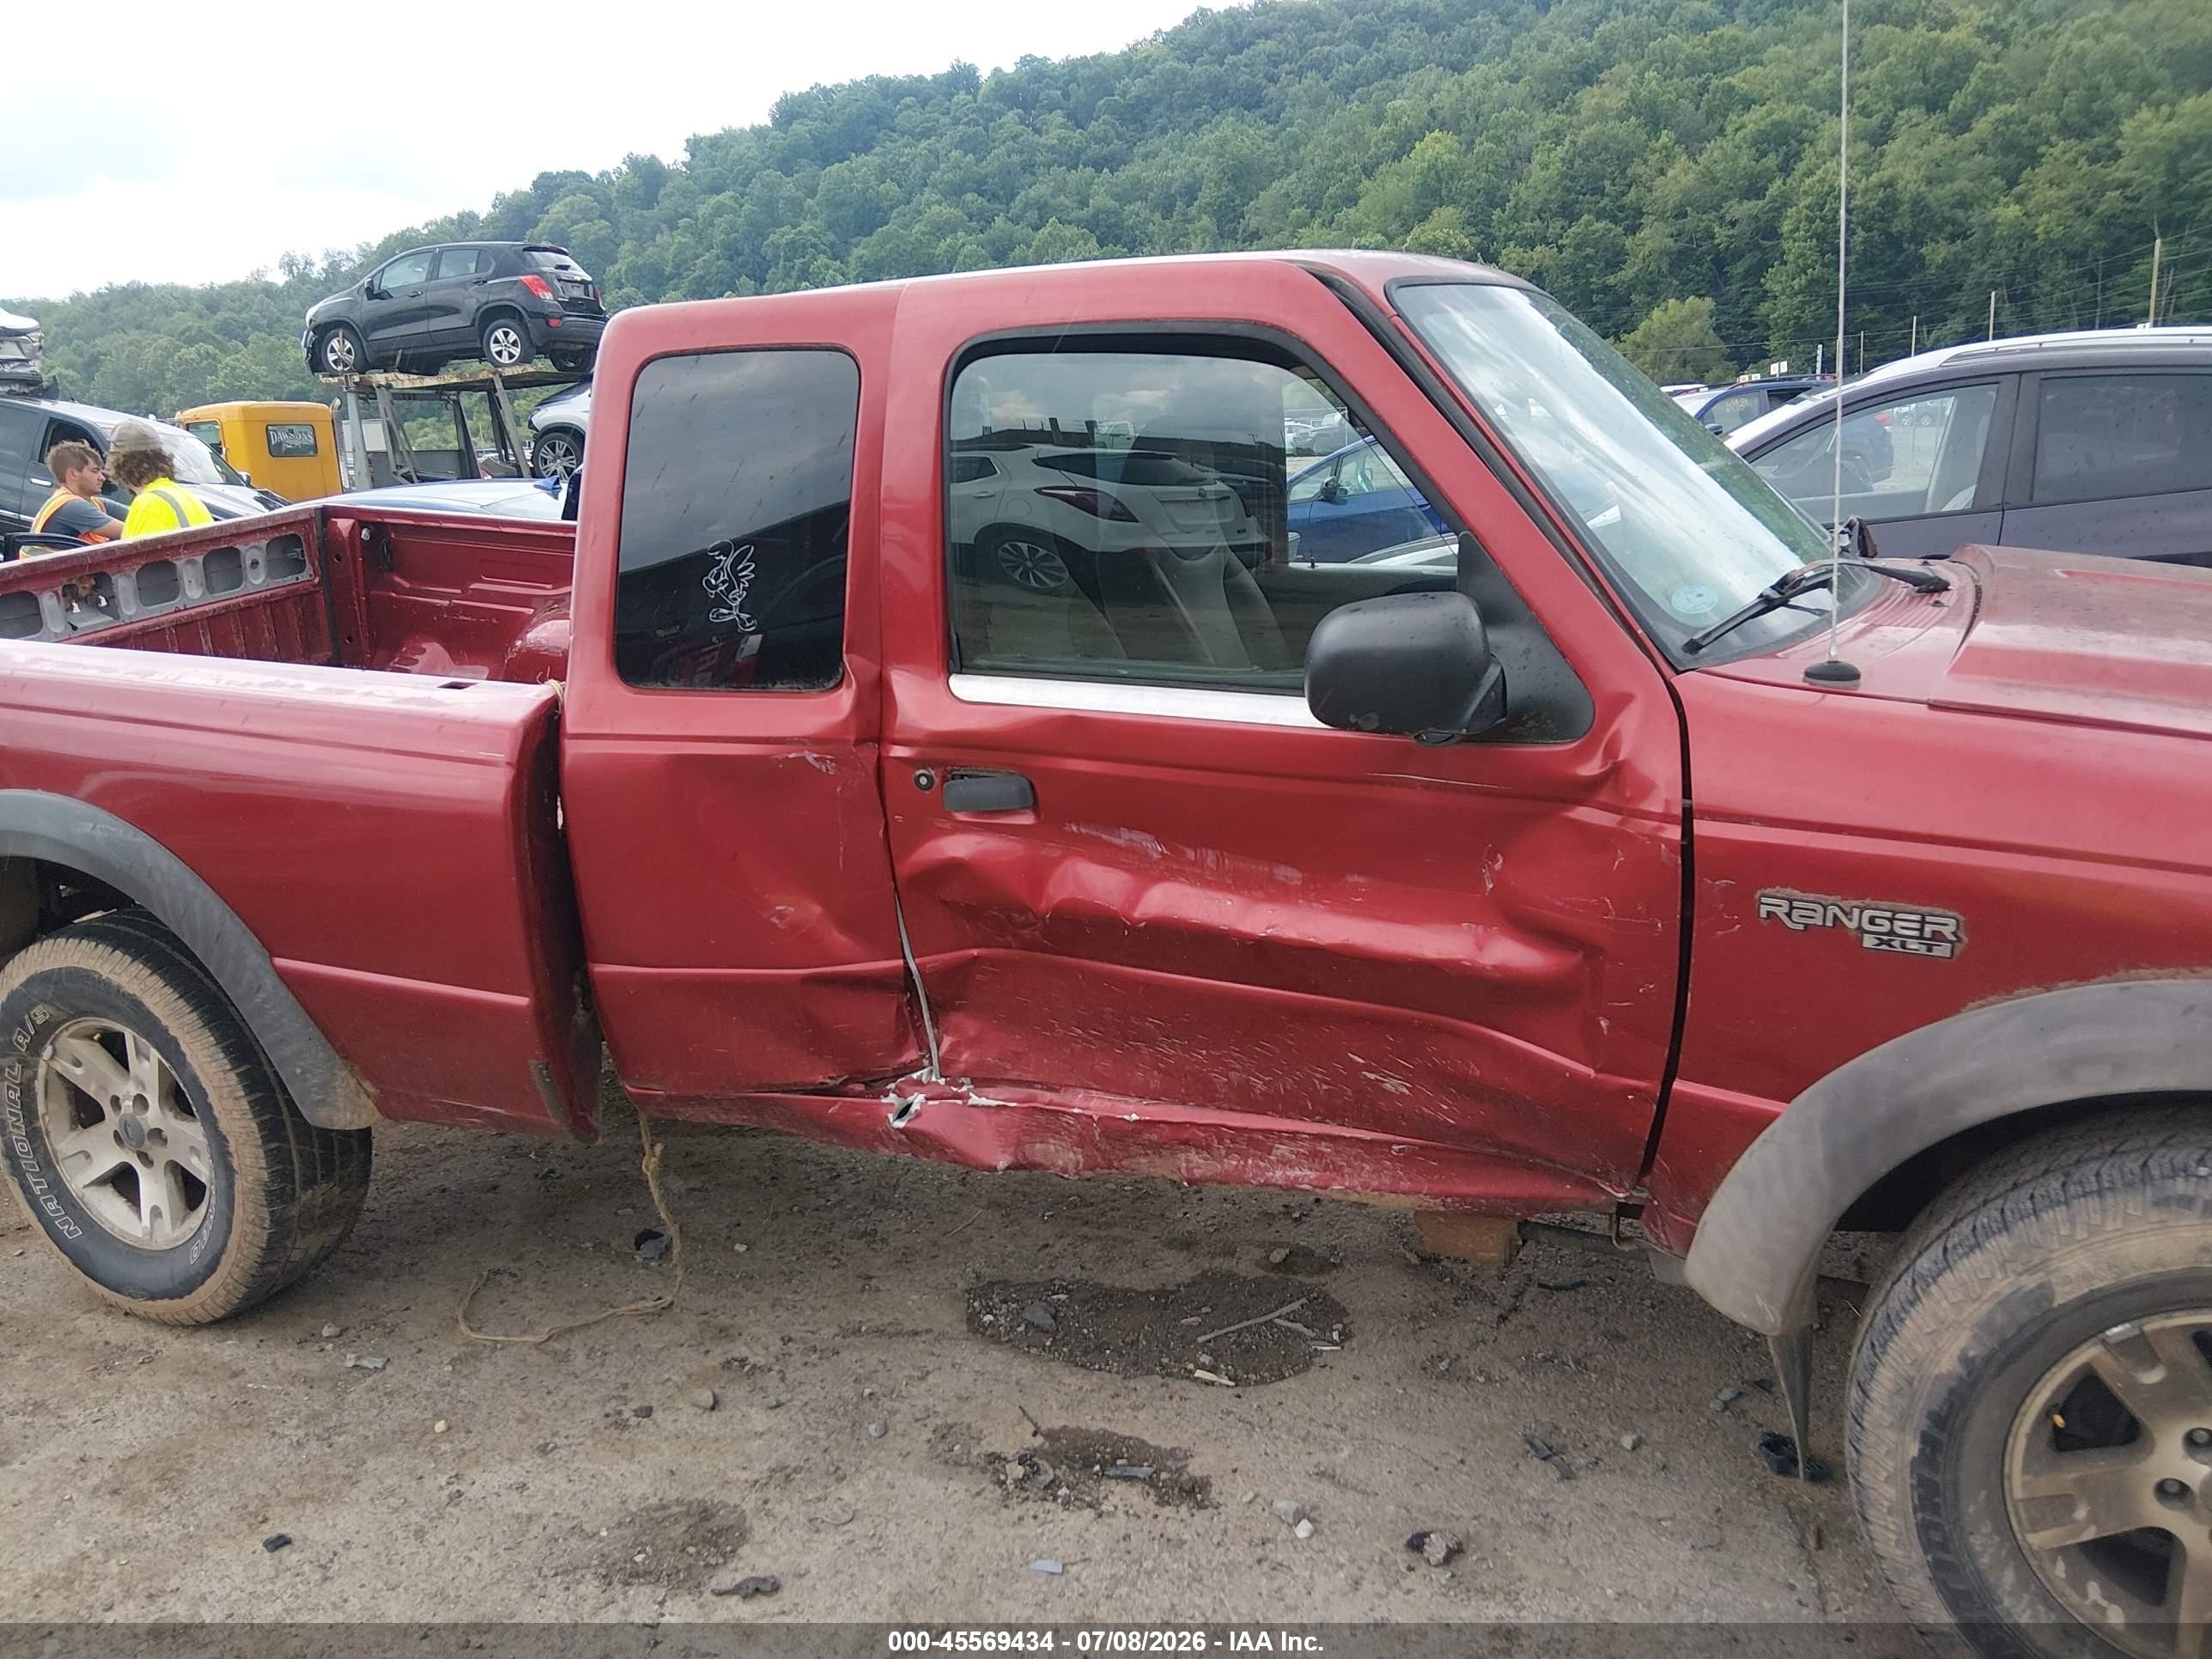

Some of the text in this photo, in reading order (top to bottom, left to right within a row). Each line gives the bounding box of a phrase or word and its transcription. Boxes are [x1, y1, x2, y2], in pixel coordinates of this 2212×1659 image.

[1870, 935, 1945, 954] XLT
[5, 1005, 83, 1239] NATIONAL A/S
